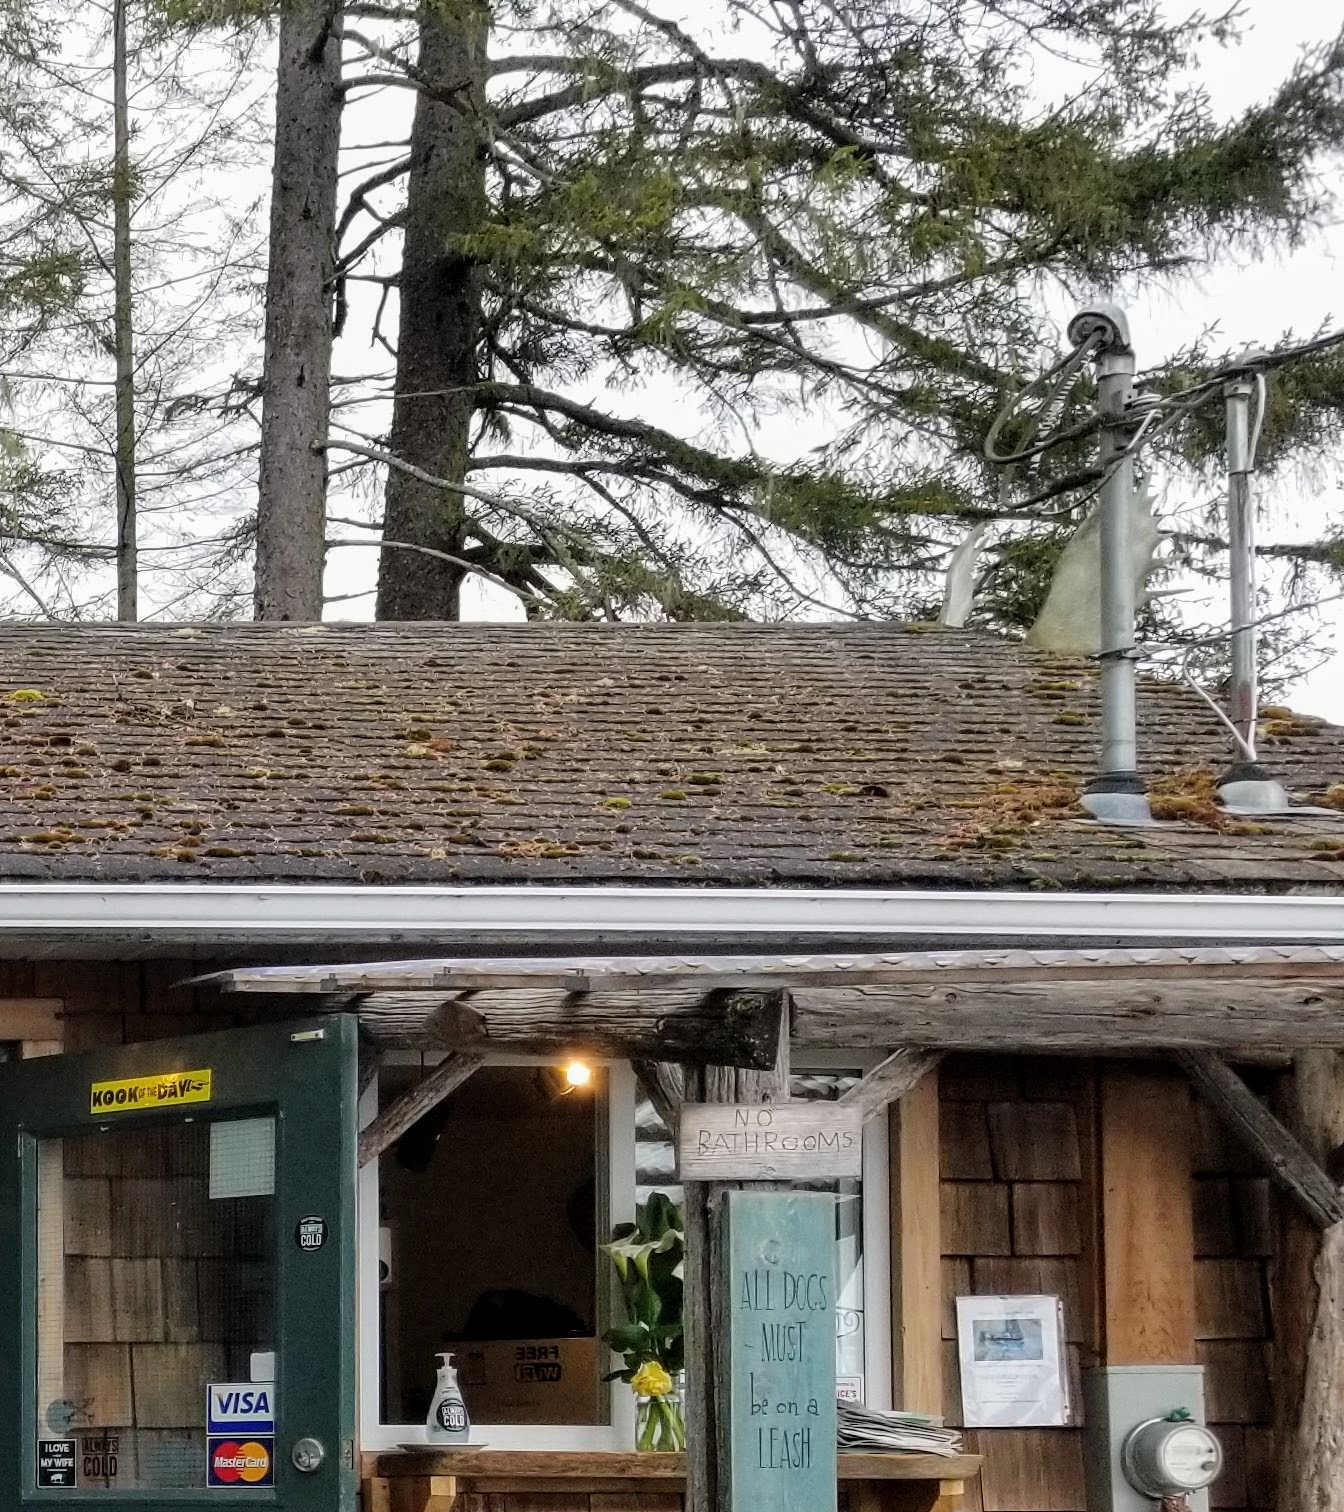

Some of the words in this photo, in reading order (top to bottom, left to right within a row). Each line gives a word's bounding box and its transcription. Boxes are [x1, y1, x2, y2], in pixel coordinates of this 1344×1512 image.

[92, 1086, 139, 1106] KOOK
[735, 1109, 772, 1127] NO
[698, 1130, 852, 1156] BATHROOMS
[301, 1234, 321, 1246] COLD
[740, 1270, 775, 1310] ALL
[784, 1271, 827, 1310] DOGS
[762, 1321, 806, 1362] MUST
[216, 1392, 269, 1414] VISA
[750, 1372, 768, 1415] be
[777, 1403, 799, 1415] on
[808, 1399, 819, 1415] a
[444, 1416, 464, 1426] COLD
[45, 1444, 48, 1452] I
[49, 1444, 70, 1452] LOVE
[758, 1428, 812, 1469] LEASH
[41, 1459, 52, 1467] MY
[55, 1458, 73, 1467] WIFE
[83, 1457, 117, 1476] COLD
[214, 1457, 268, 1468] MasterCard
